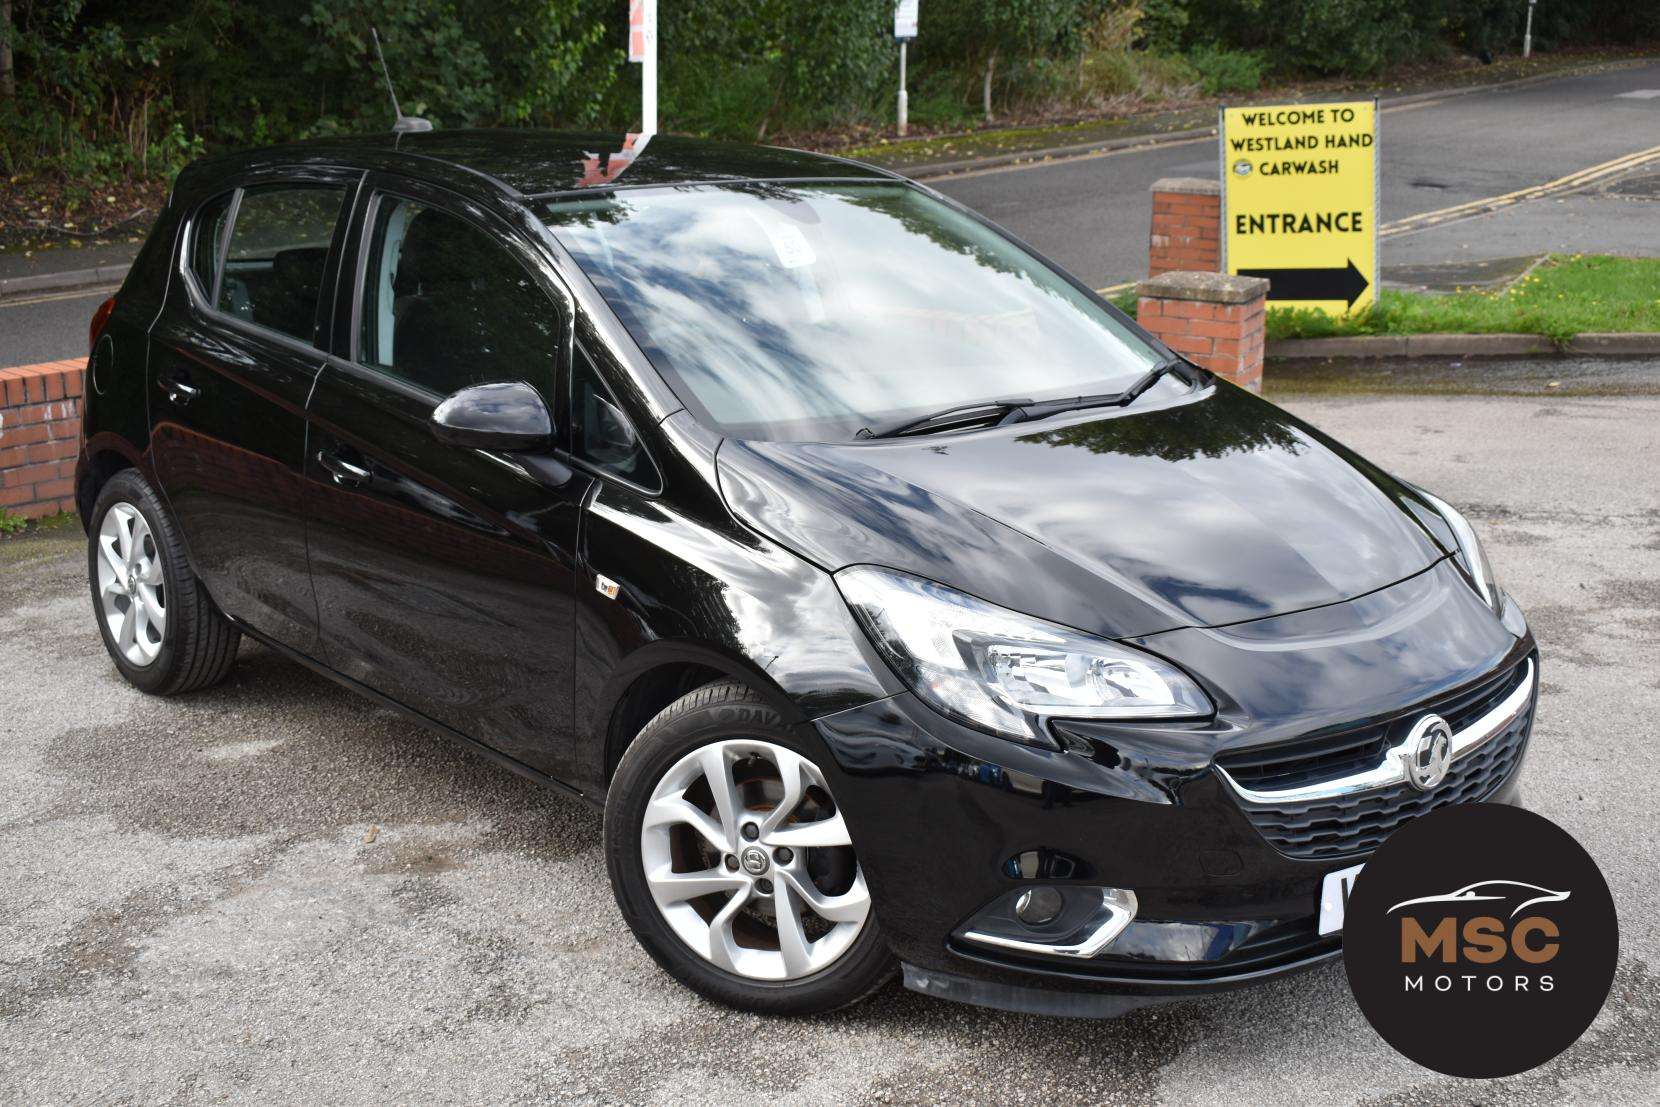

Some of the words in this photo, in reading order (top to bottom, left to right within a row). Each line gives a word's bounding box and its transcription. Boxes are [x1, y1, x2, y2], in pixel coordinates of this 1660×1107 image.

[1242, 110, 1325, 126] WELCOME
[1330, 108, 1355, 123] TO
[1231, 135, 1319, 152] WESTLAND
[1325, 133, 1373, 149] HAND
[1259, 159, 1339, 176] CARWASH
[1236, 211, 1363, 235] ENTRANCE
